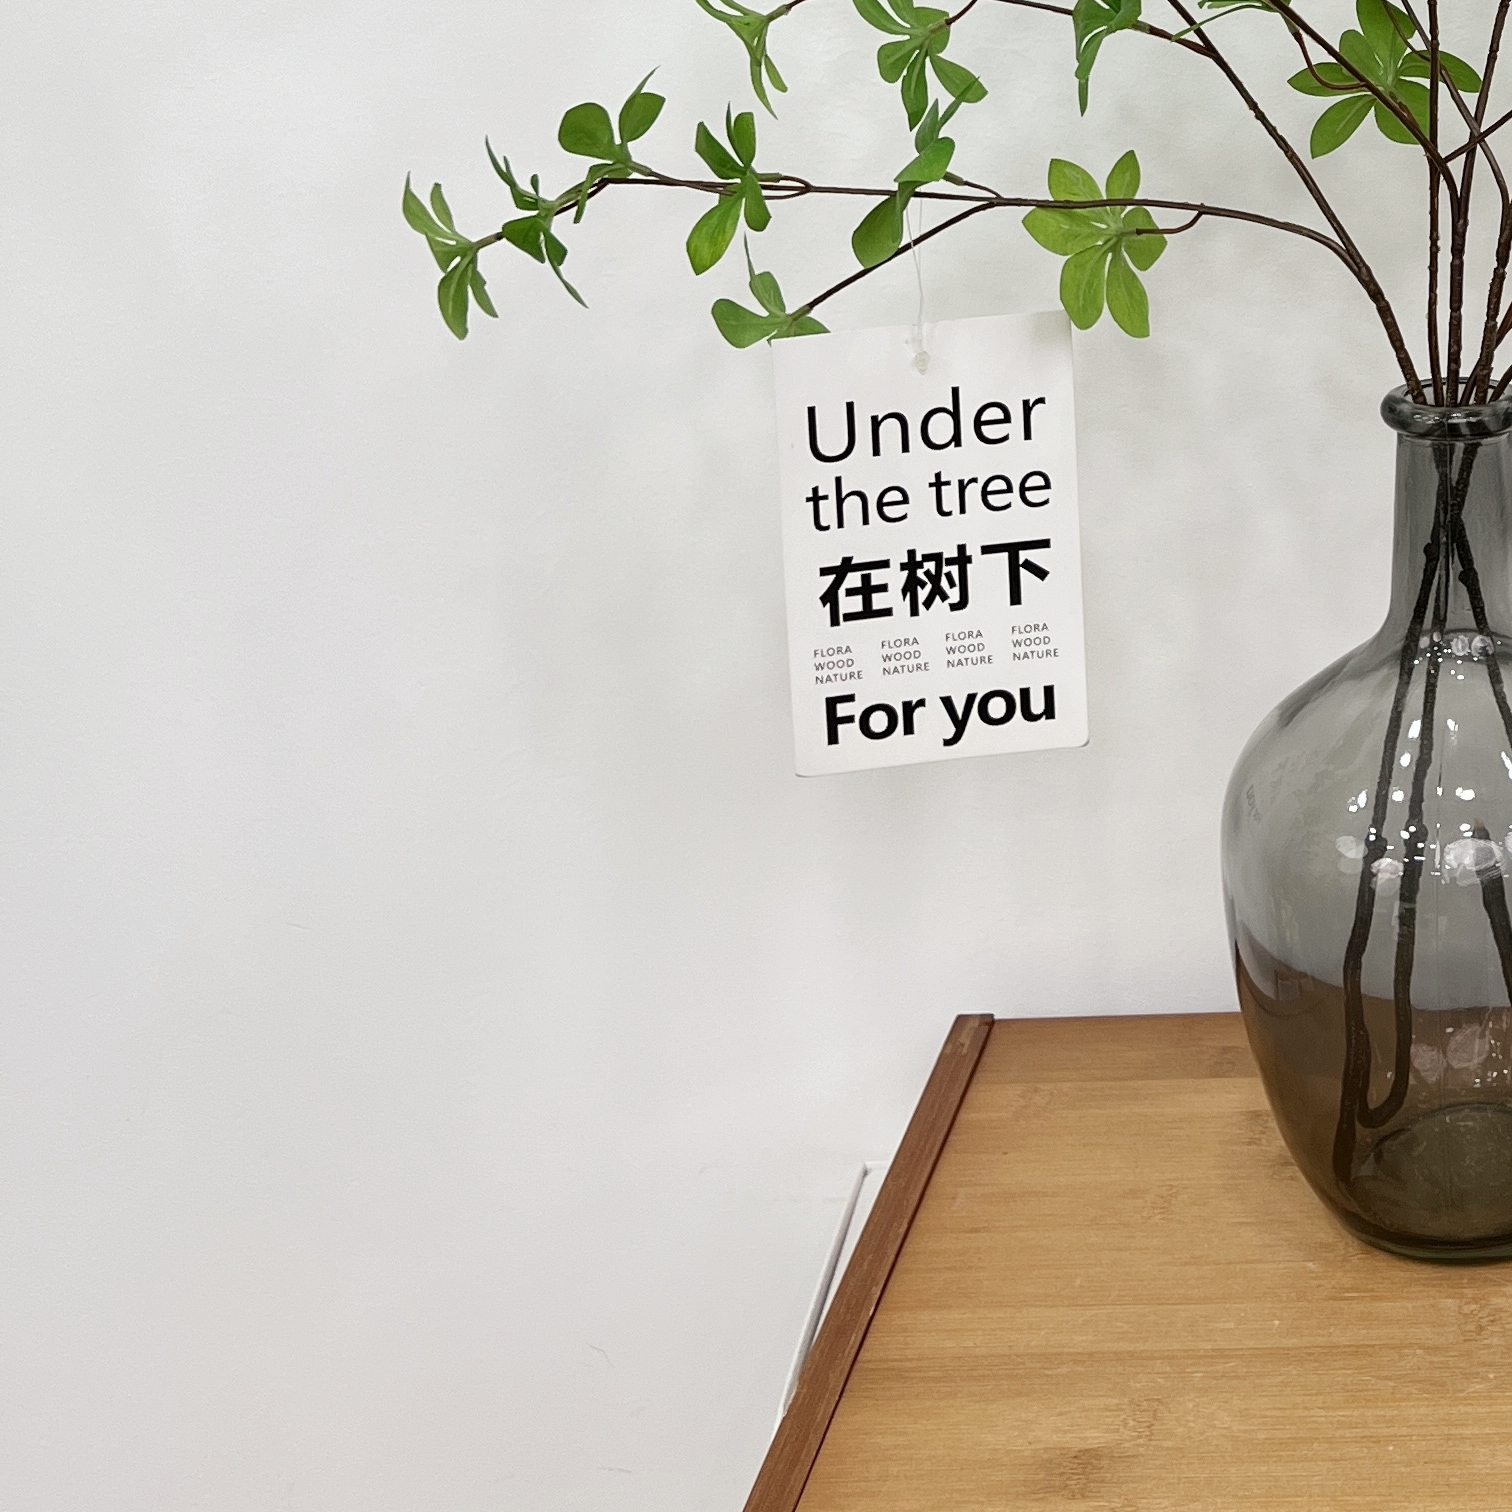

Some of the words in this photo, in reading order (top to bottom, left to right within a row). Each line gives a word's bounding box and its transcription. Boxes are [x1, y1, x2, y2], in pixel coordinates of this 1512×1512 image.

[806, 385, 1047, 464] Under
[805, 475, 910, 532] the
[928, 469, 1052, 517] tree
[818, 538, 1052, 628] 在树下
[813, 645, 852, 658] FLORA
[881, 637, 919, 649] FLORA
[945, 630, 984, 642] FLORA
[1011, 623, 1049, 635] FLORA
[814, 658, 855, 671] WOOD
[882, 650, 922, 662] WOOD
[946, 642, 985, 655] WOOD
[1012, 636, 1051, 648] WOOD
[815, 671, 863, 685] NATURE
[883, 662, 930, 676] NATURE
[947, 655, 993, 668] NATURE
[1013, 648, 1059, 661] NATURE
[824, 693, 926, 746] For
[938, 684, 1056, 747] you
